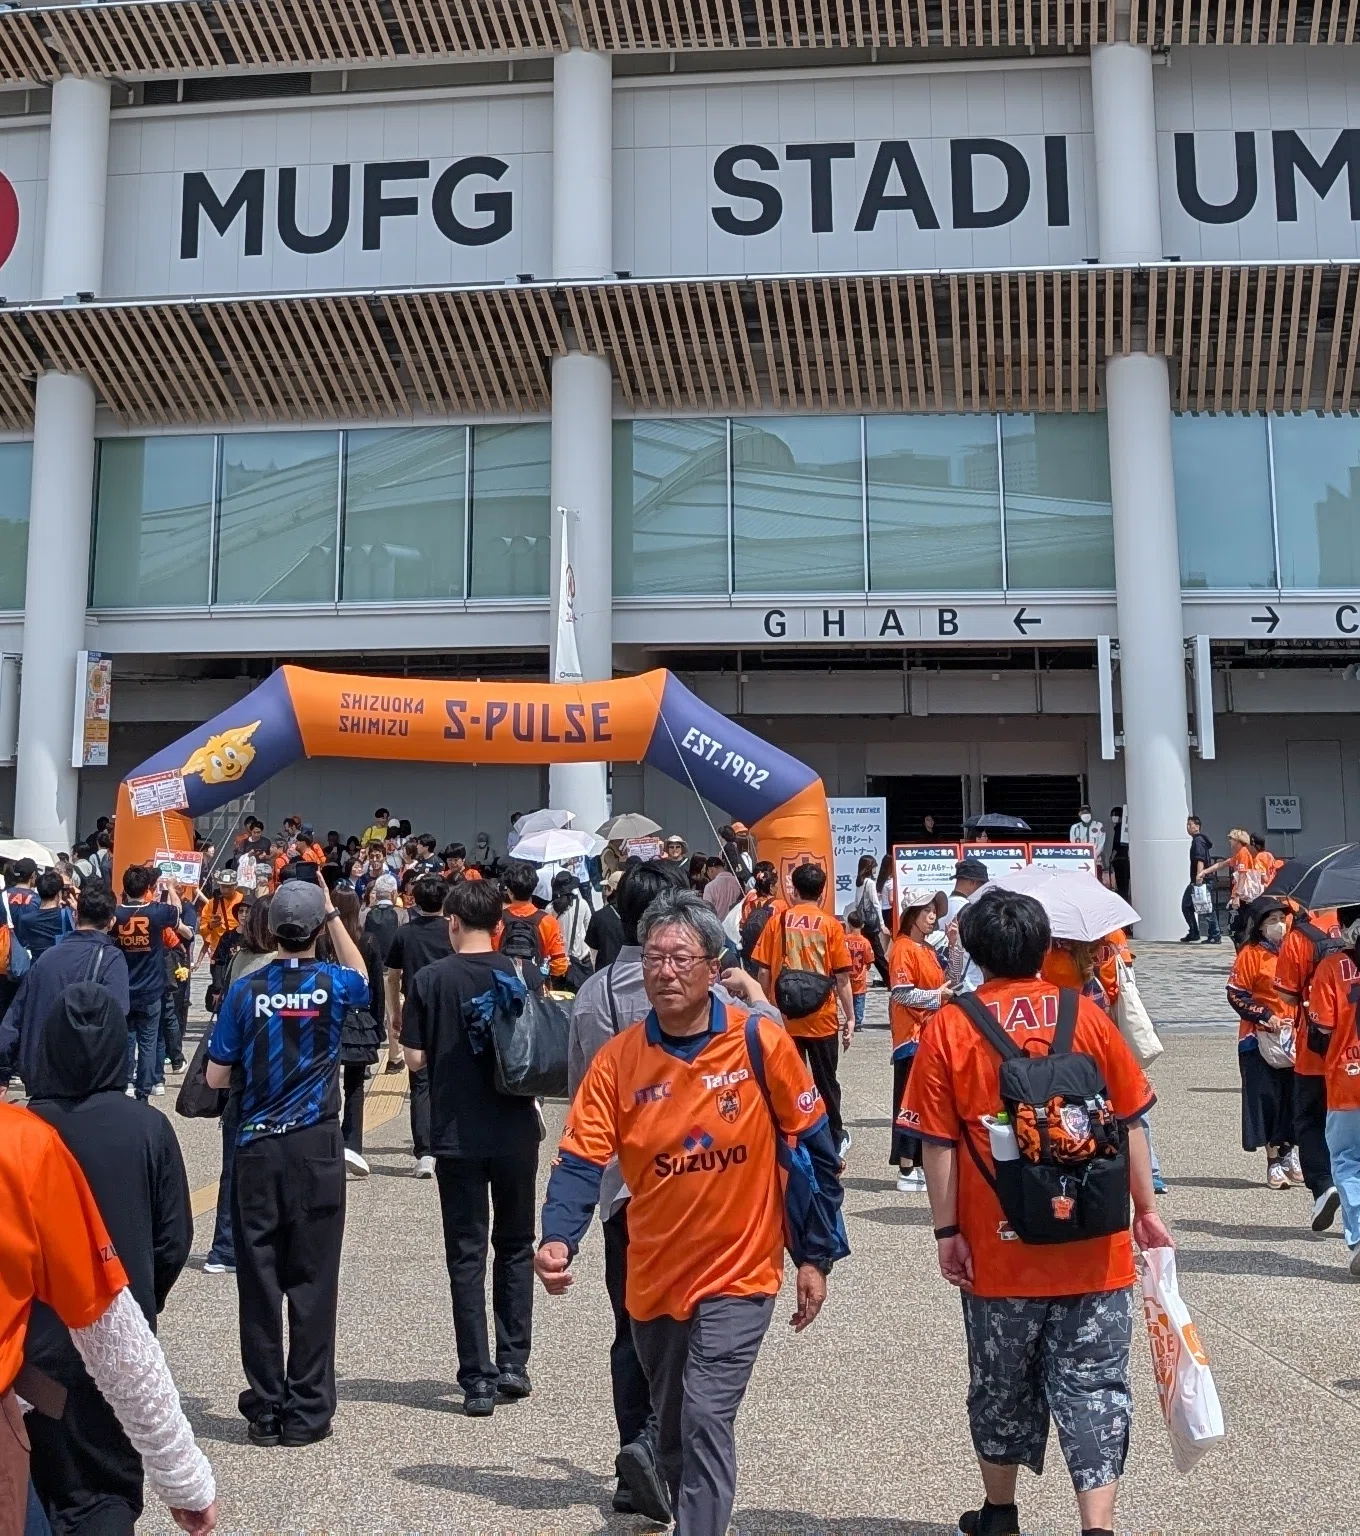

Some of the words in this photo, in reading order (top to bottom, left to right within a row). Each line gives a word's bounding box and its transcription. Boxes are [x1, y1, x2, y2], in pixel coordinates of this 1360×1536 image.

[180, 155, 513, 259] MUFG
[764, 609, 786, 637] G
[823, 609, 845, 637] H
[879, 608, 905, 636] A
[938, 608, 959, 635] B
[1336, 604, 1359, 633] C
[341, 692, 424, 715] SHIZUOKA
[339, 715, 409, 737] SHIMIZU
[443, 699, 613, 743] S-PULSE
[681, 726, 770, 791] EST.1992
[838, 835, 874, 844] 付きシート
[119, 916, 150, 934] JR
[785, 913, 823, 930] IAI
[255, 989, 328, 1018] ROHTO
[701, 1066, 749, 1090] Taica
[654, 1145, 748, 1178] Suzuyo
